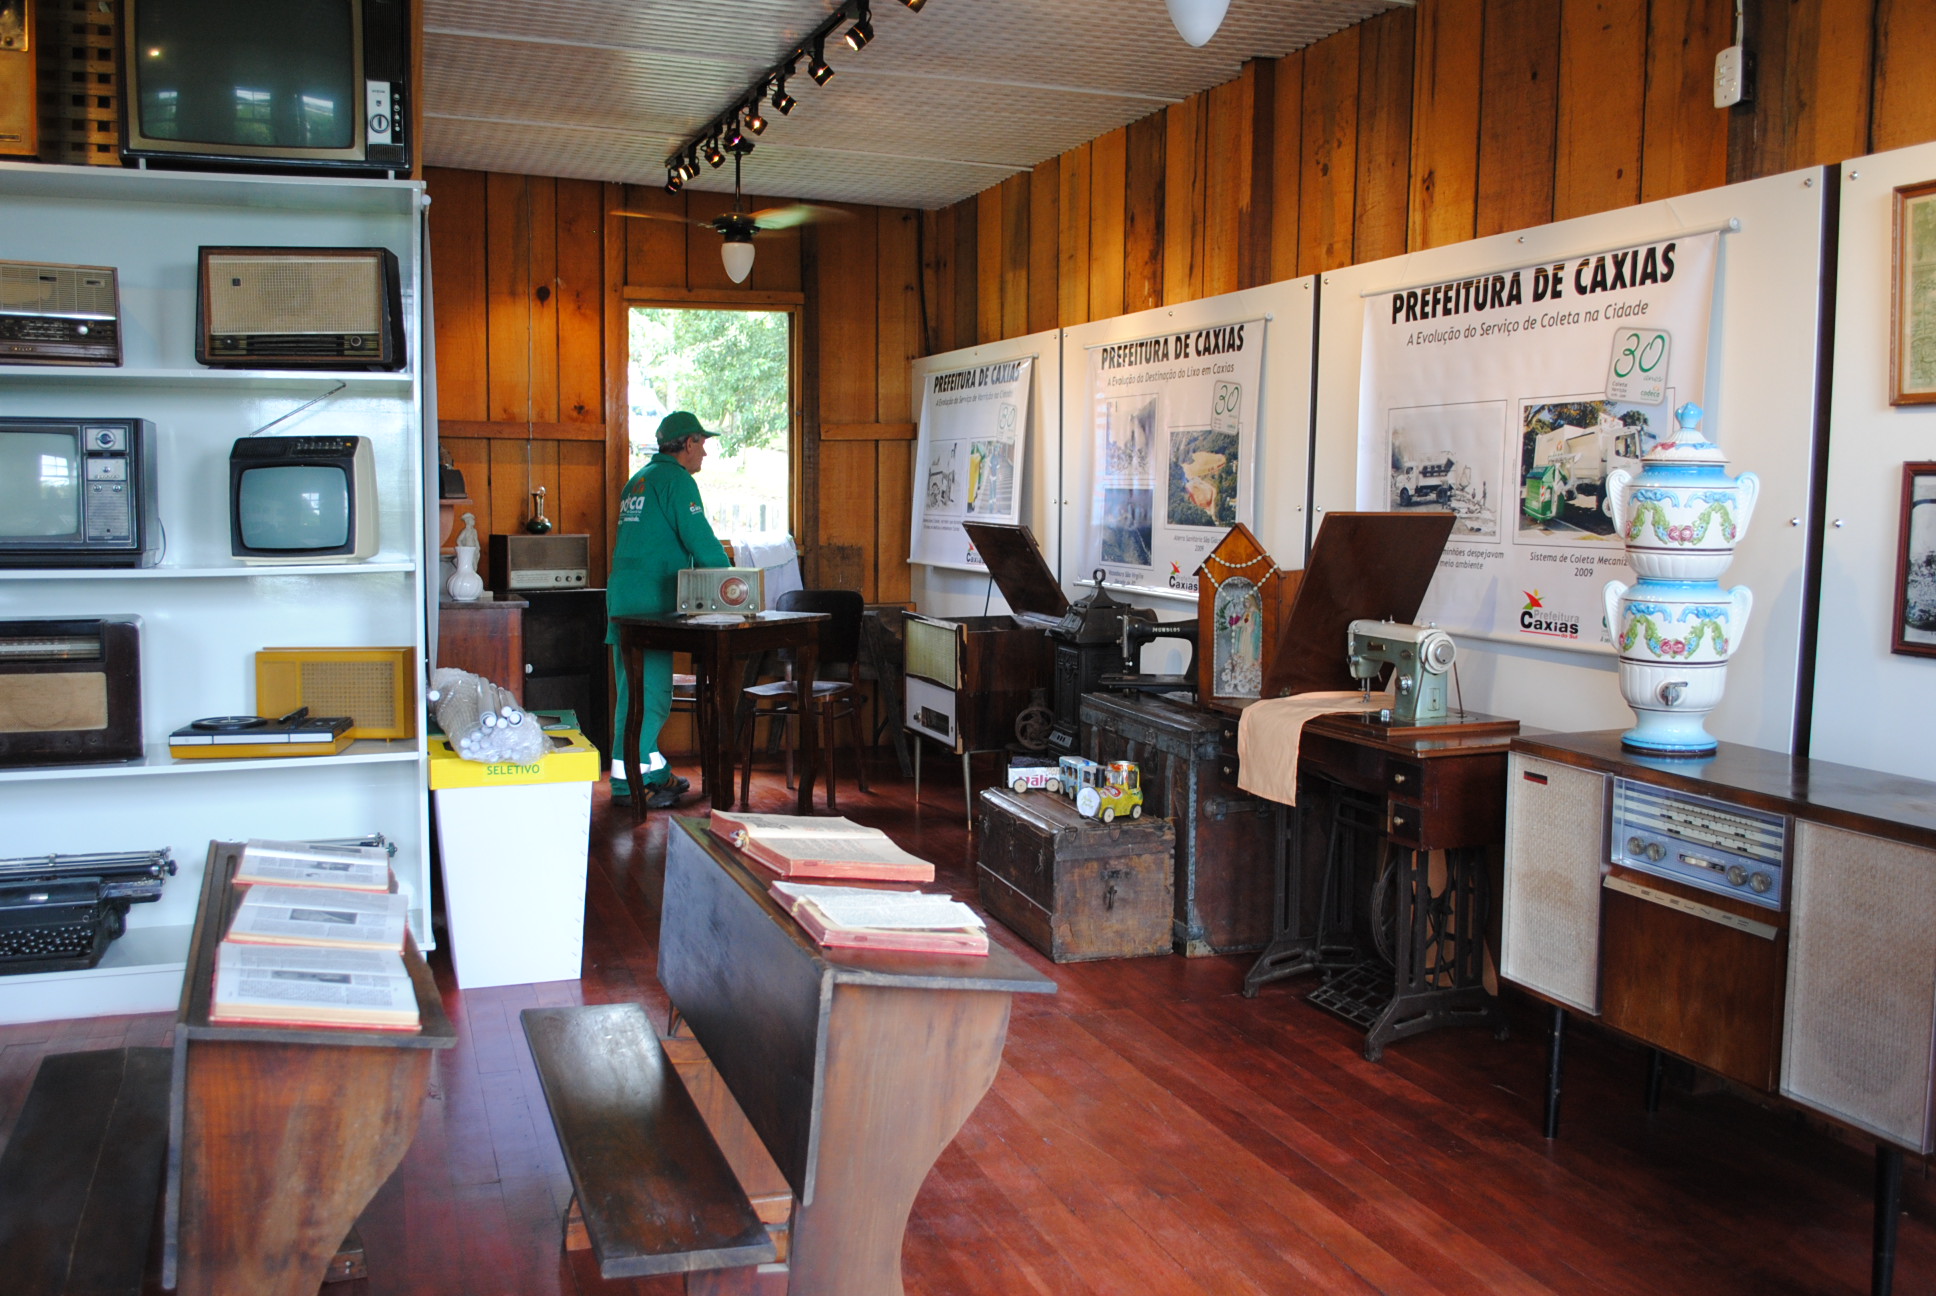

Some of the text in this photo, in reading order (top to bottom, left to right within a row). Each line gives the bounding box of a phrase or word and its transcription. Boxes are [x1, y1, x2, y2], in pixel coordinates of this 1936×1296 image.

[1391, 243, 1676, 325] PREFEITURA DE CAXIAS
[1406, 299, 1649, 347] A Evolução do Serviço de Coleta na Cidade
[1101, 324, 1245, 371] PREFEITURA DE CAXIAS
[1614, 332, 1665, 379] 30
[933, 361, 1021, 394] PREFEITURA DE CAXIAS
[1112, 375, 1136, 387] Evolução
[1145, 369, 1177, 383] Destinação
[1186, 366, 1200, 377] Lixo
[1202, 365, 1211, 376] em
[1212, 361, 1235, 374] Caxias
[1214, 384, 1239, 415] 30
[999, 406, 1015, 430] 30
[1455, 559, 1484, 570] ambiente
[1466, 550, 1504, 560] despejavam
[1530, 551, 1558, 564] Sistema
[1558, 554, 1568, 563] de
[1569, 554, 1595, 565] Coleta
[1168, 575, 1198, 592] Caxias
[1574, 567, 1594, 578] 2009
[1520, 610, 1579, 635] Caxias
[1534, 608, 1580, 623] Prefeitura
[487, 764, 540, 776] SELETIVO
